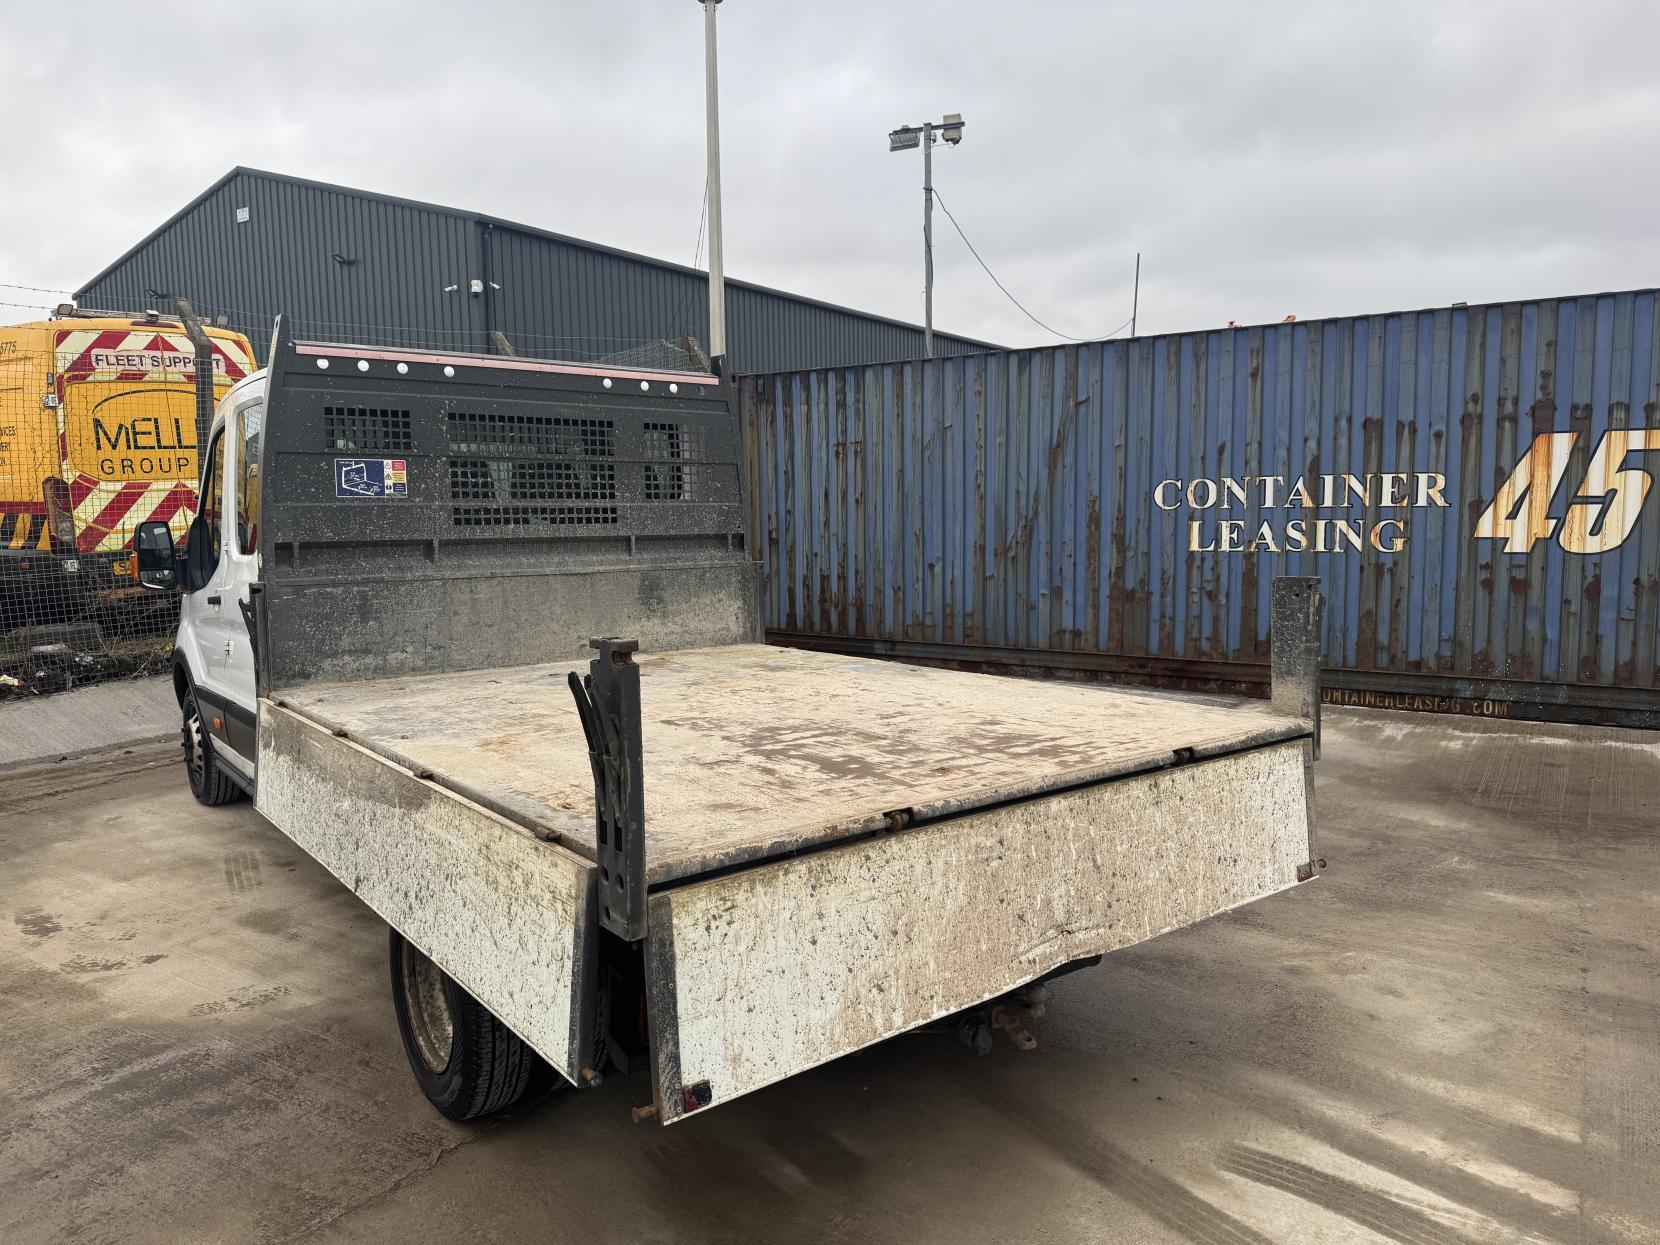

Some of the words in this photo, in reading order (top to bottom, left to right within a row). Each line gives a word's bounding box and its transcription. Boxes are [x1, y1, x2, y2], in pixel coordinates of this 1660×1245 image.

[94, 354, 146, 367] FLEET
[151, 355, 221, 369] SUPPT
[93, 417, 198, 451] MELL
[100, 457, 190, 475] GROUP
[1153, 472, 1452, 511] CONTAINER
[1475, 430, 1660, 554] 45
[1188, 519, 1408, 554] LEASING
